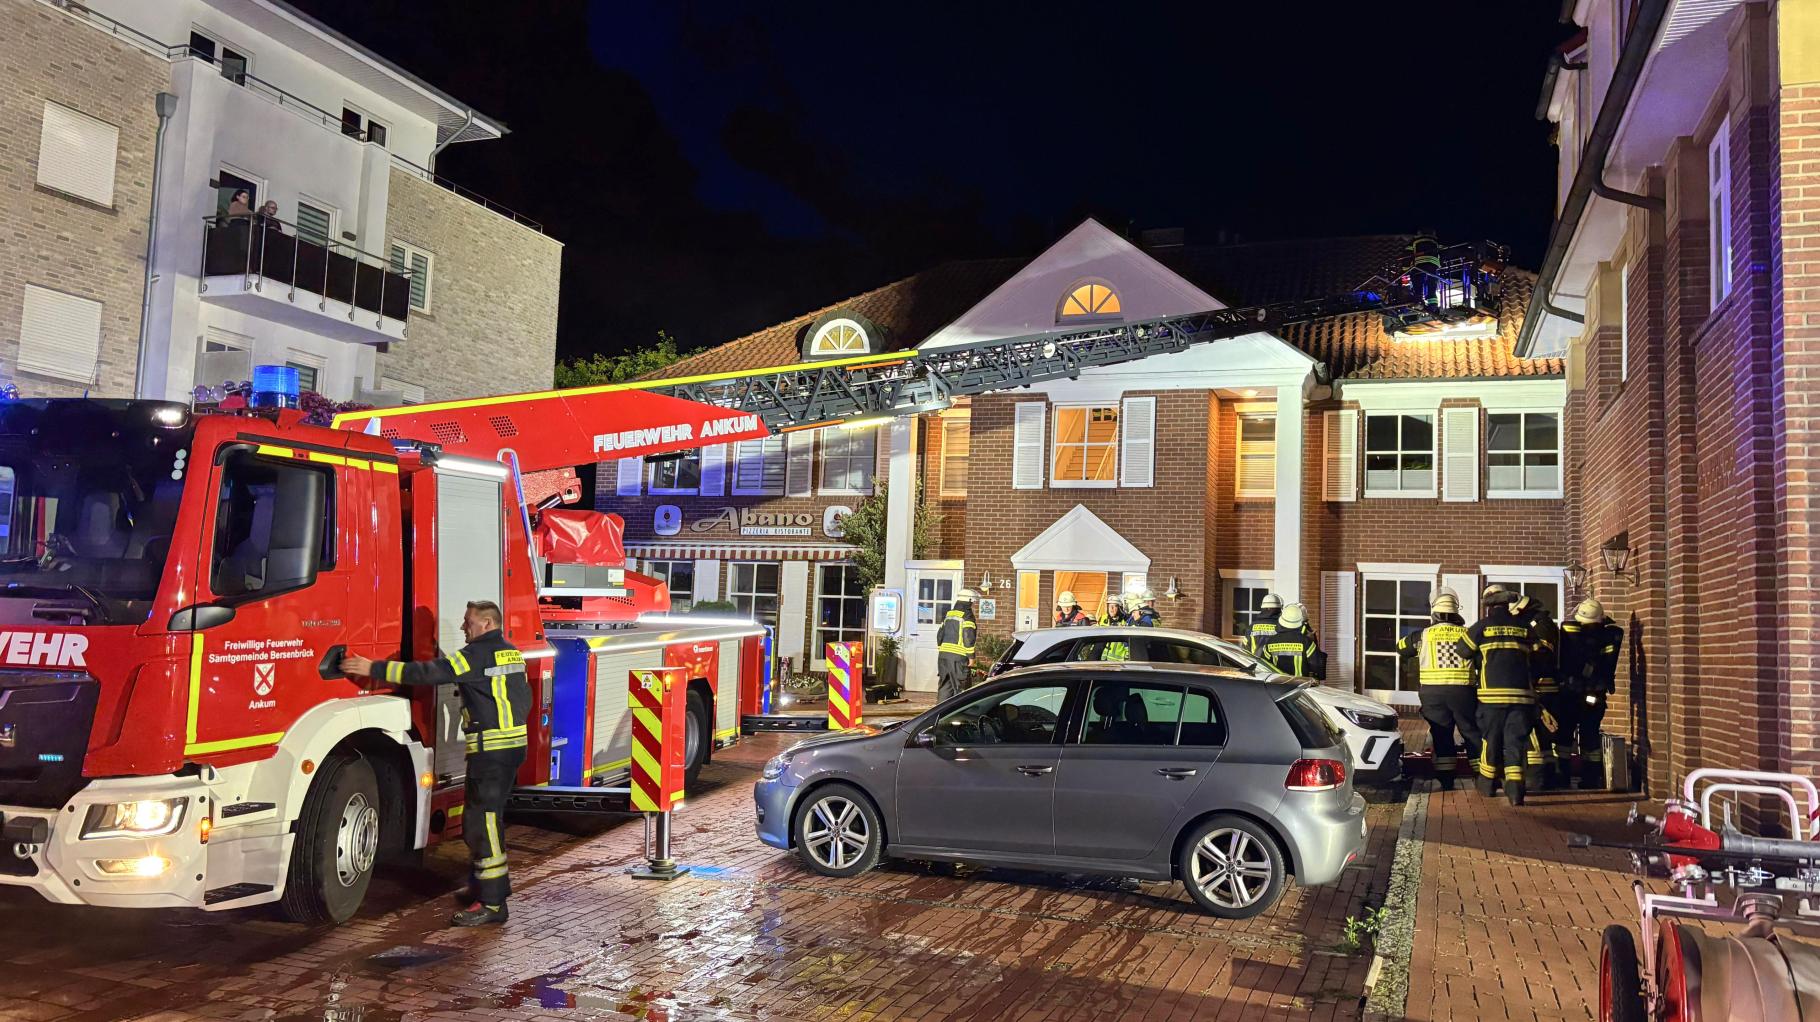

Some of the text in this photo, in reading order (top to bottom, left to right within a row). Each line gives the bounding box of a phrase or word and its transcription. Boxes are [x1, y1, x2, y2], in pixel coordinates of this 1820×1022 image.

[594, 414, 758, 453] FEUERWEHR ANKUM
[690, 507, 814, 532] Abano
[1000, 580, 1011, 588] 26
[224, 638, 304, 651] Freiwillige Feuerwehr
[208, 648, 315, 664] Samtgemeinde Bersenbrück
[248, 700, 276, 709] Ankum
